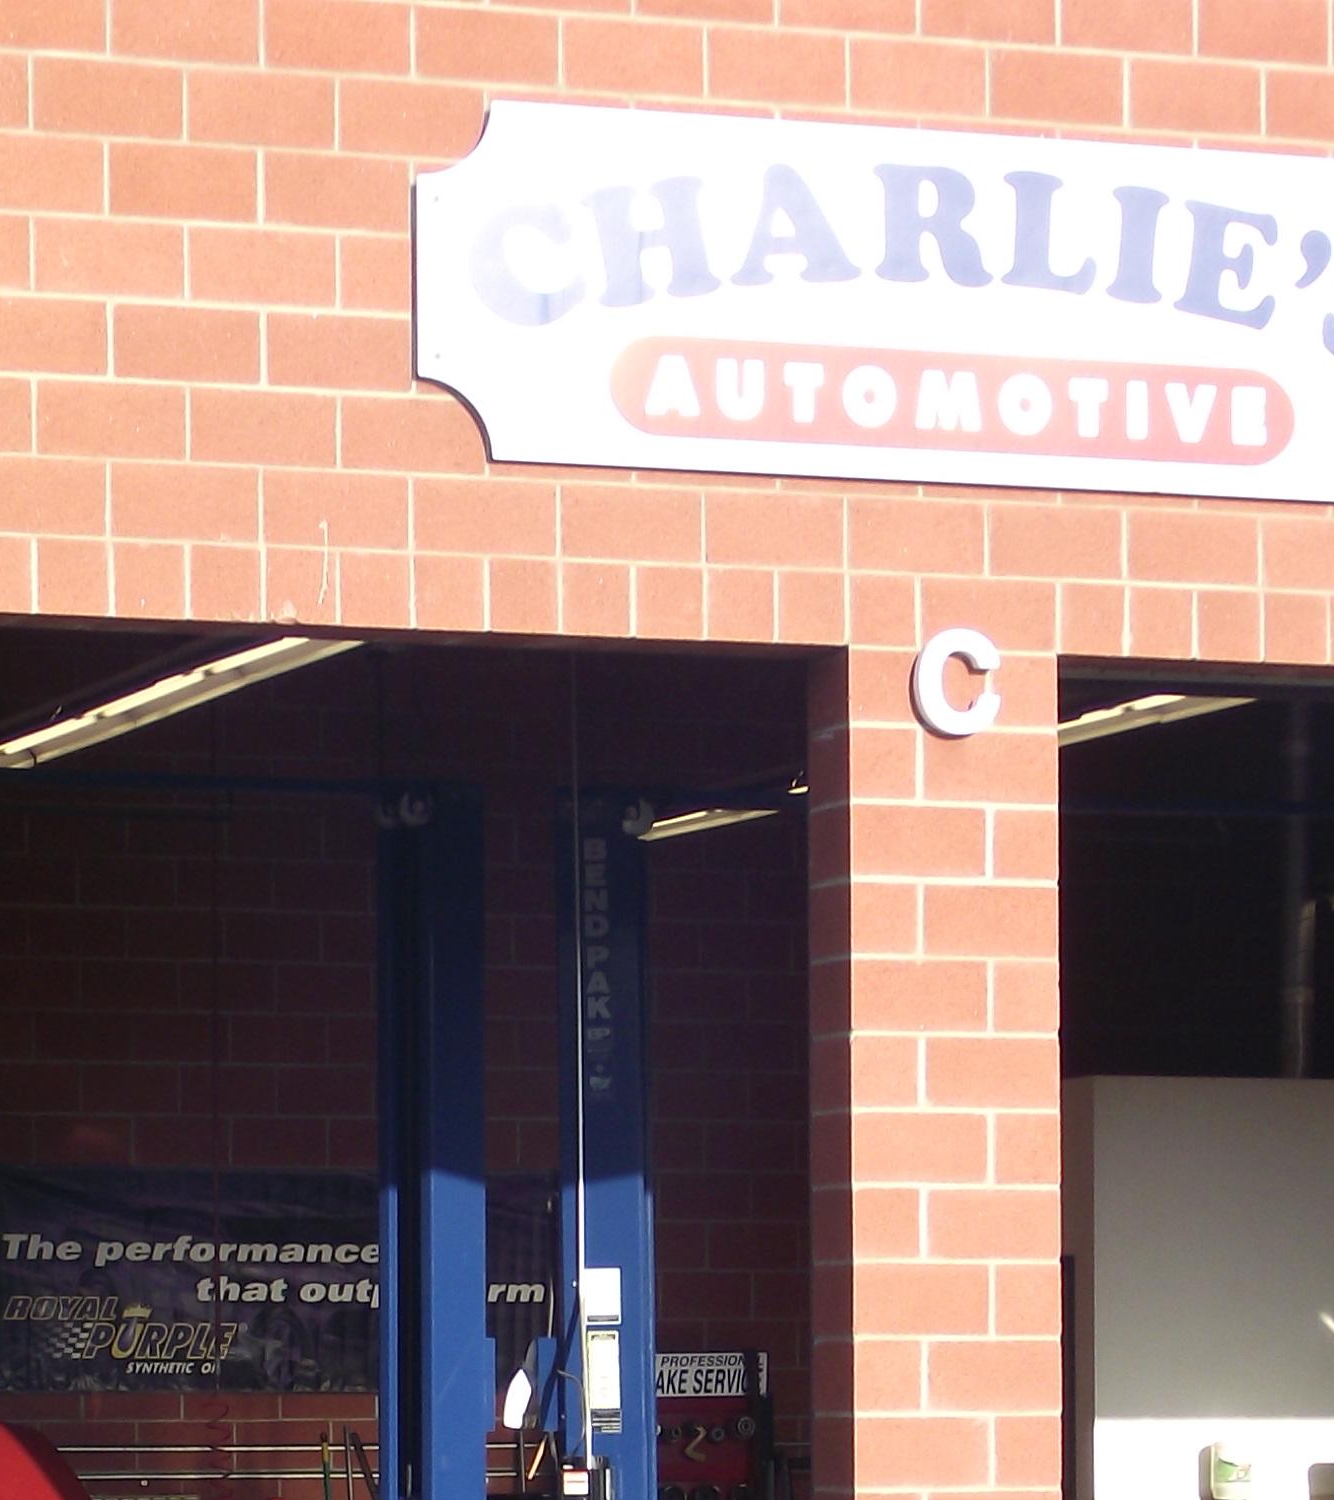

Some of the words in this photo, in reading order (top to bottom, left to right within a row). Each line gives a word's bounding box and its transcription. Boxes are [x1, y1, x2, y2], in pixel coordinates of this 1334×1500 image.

[644, 353, 1270, 447] AUTOMOTIVE
[912, 627, 1002, 737] C
[2, 1233, 82, 1261] The
[94, 1235, 380, 1268] performance
[195, 1276, 289, 1303] that
[2, 1296, 119, 1320] ROYAL
[82, 1322, 238, 1360] PURPLE
[126, 1361, 195, 1375] SYNTHETIC
[656, 1369, 689, 1394] AKE
